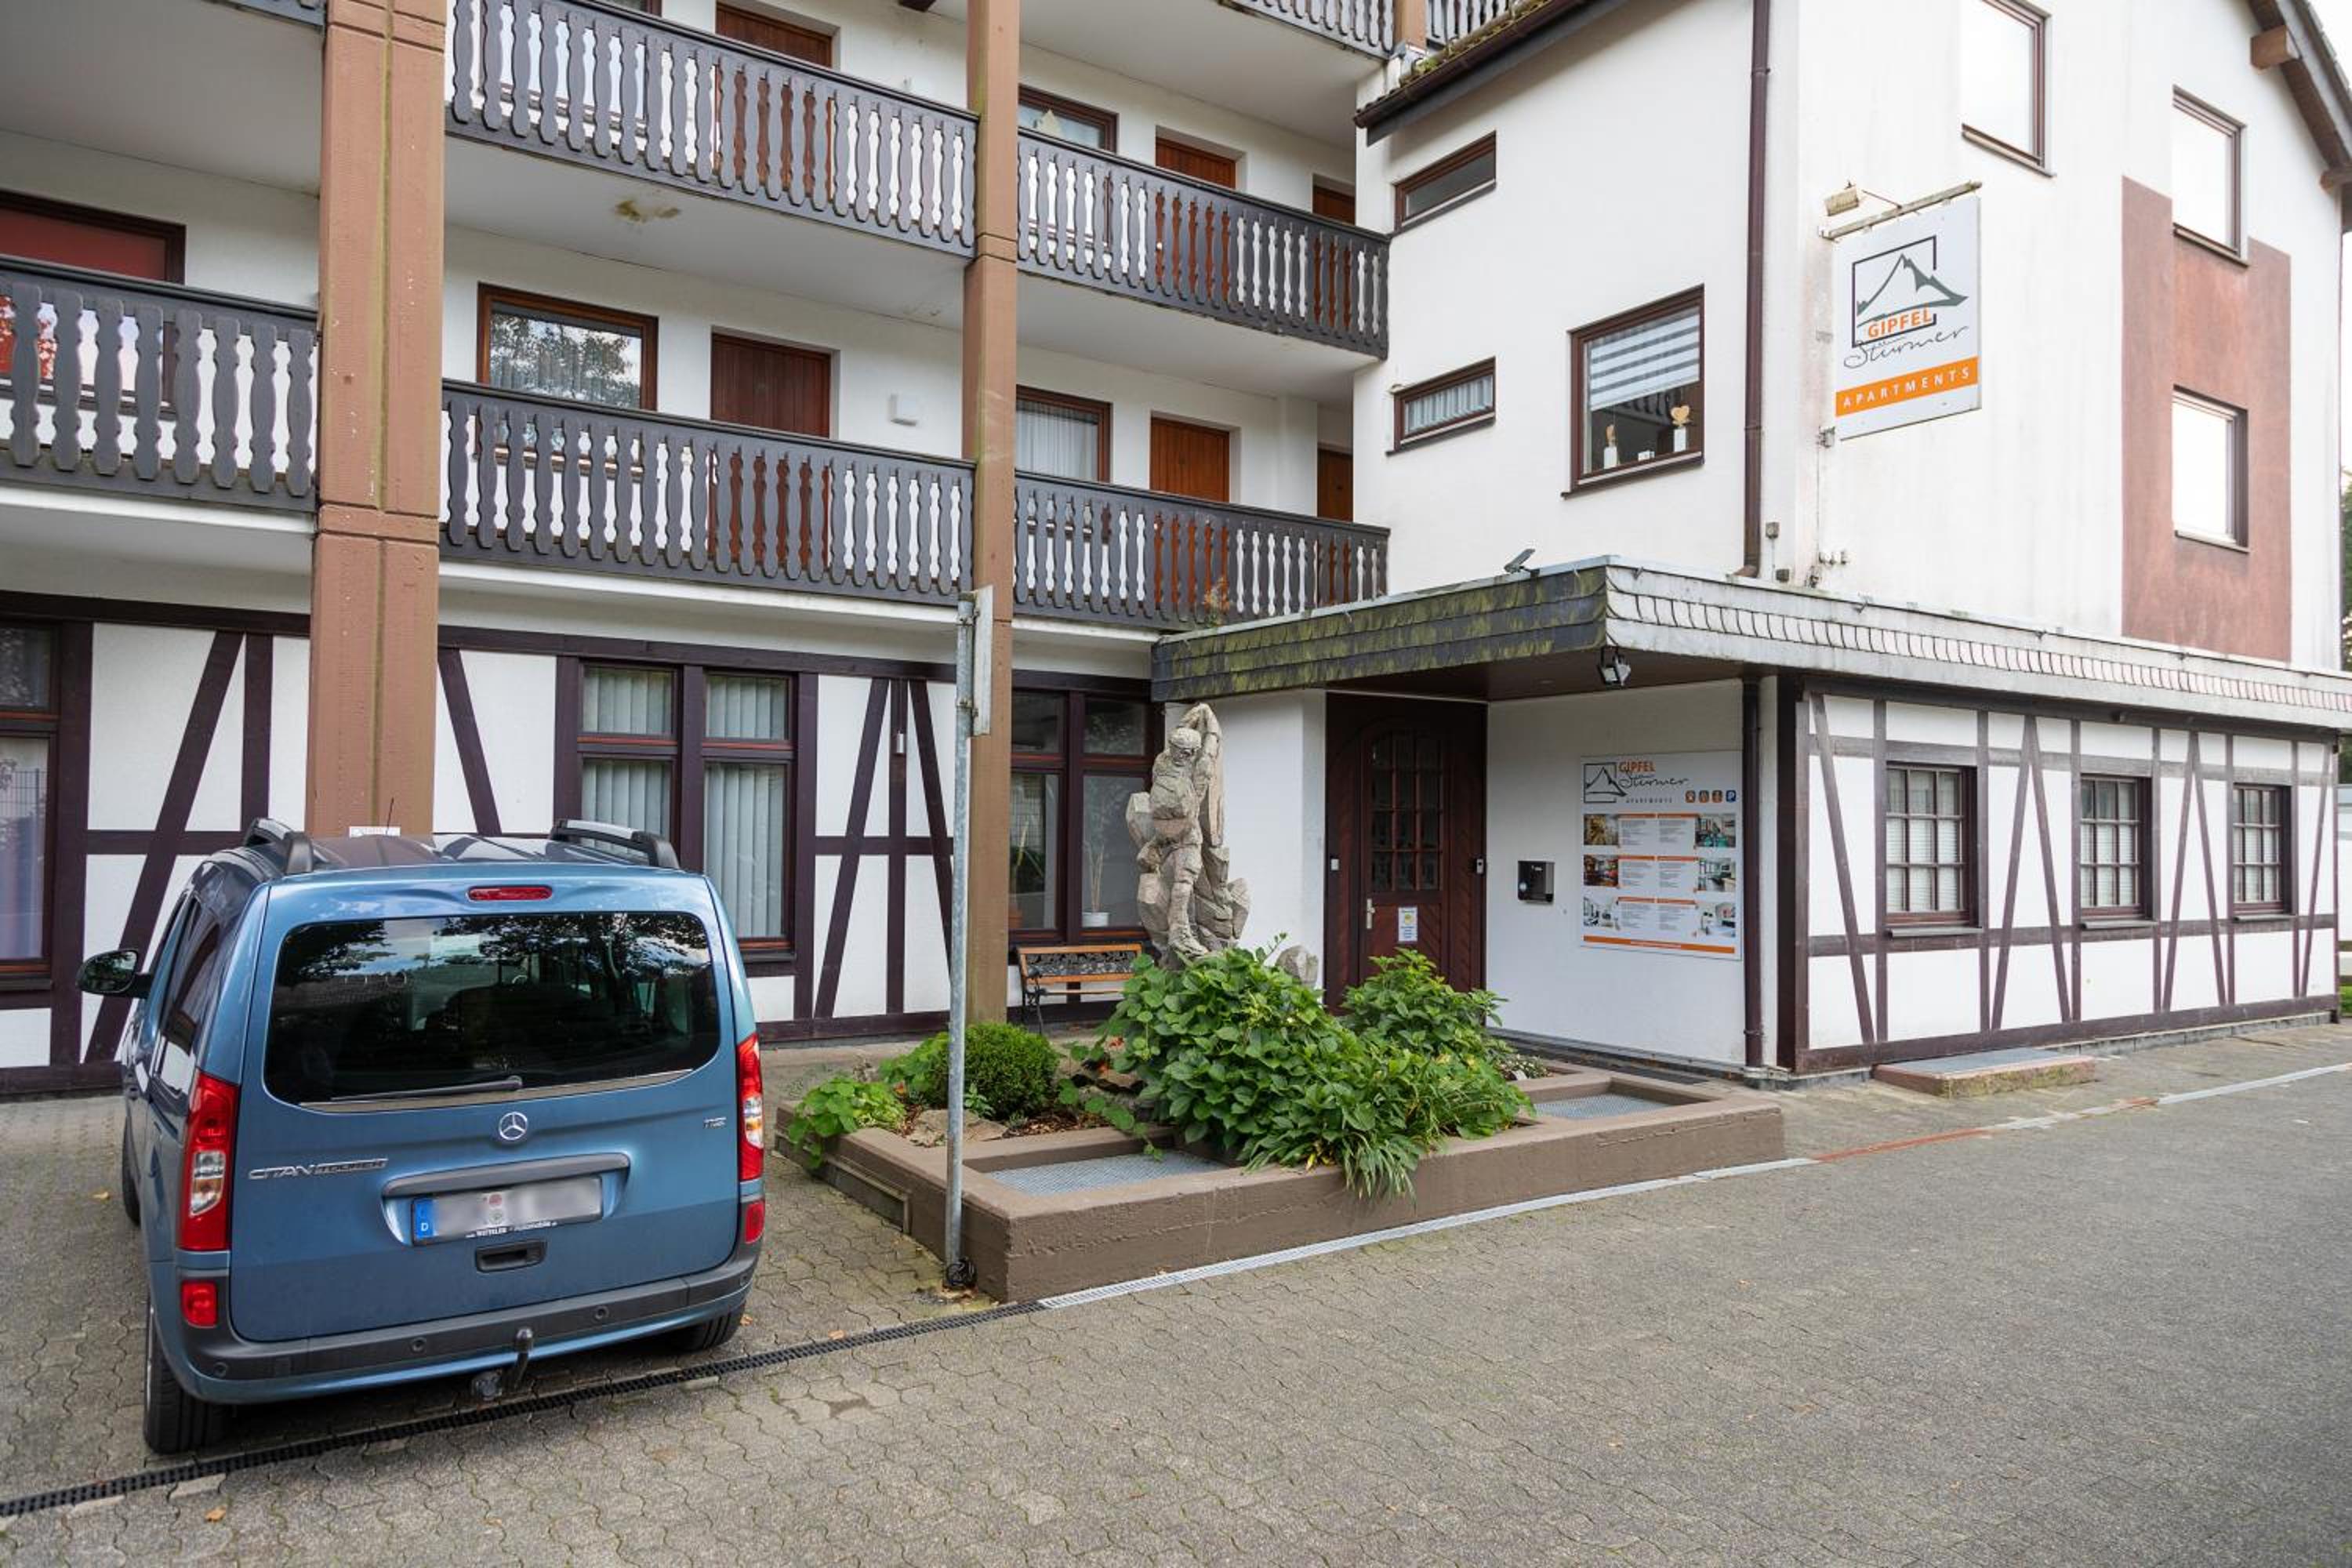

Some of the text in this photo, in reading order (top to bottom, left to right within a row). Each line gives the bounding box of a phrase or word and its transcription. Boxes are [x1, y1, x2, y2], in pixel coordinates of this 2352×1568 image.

[1868, 304, 1932, 339] GIPFEL
[1843, 366, 1969, 408] APARTMENTS
[1619, 761, 1656, 772] GIPFEL
[421, 1222, 429, 1232] D
